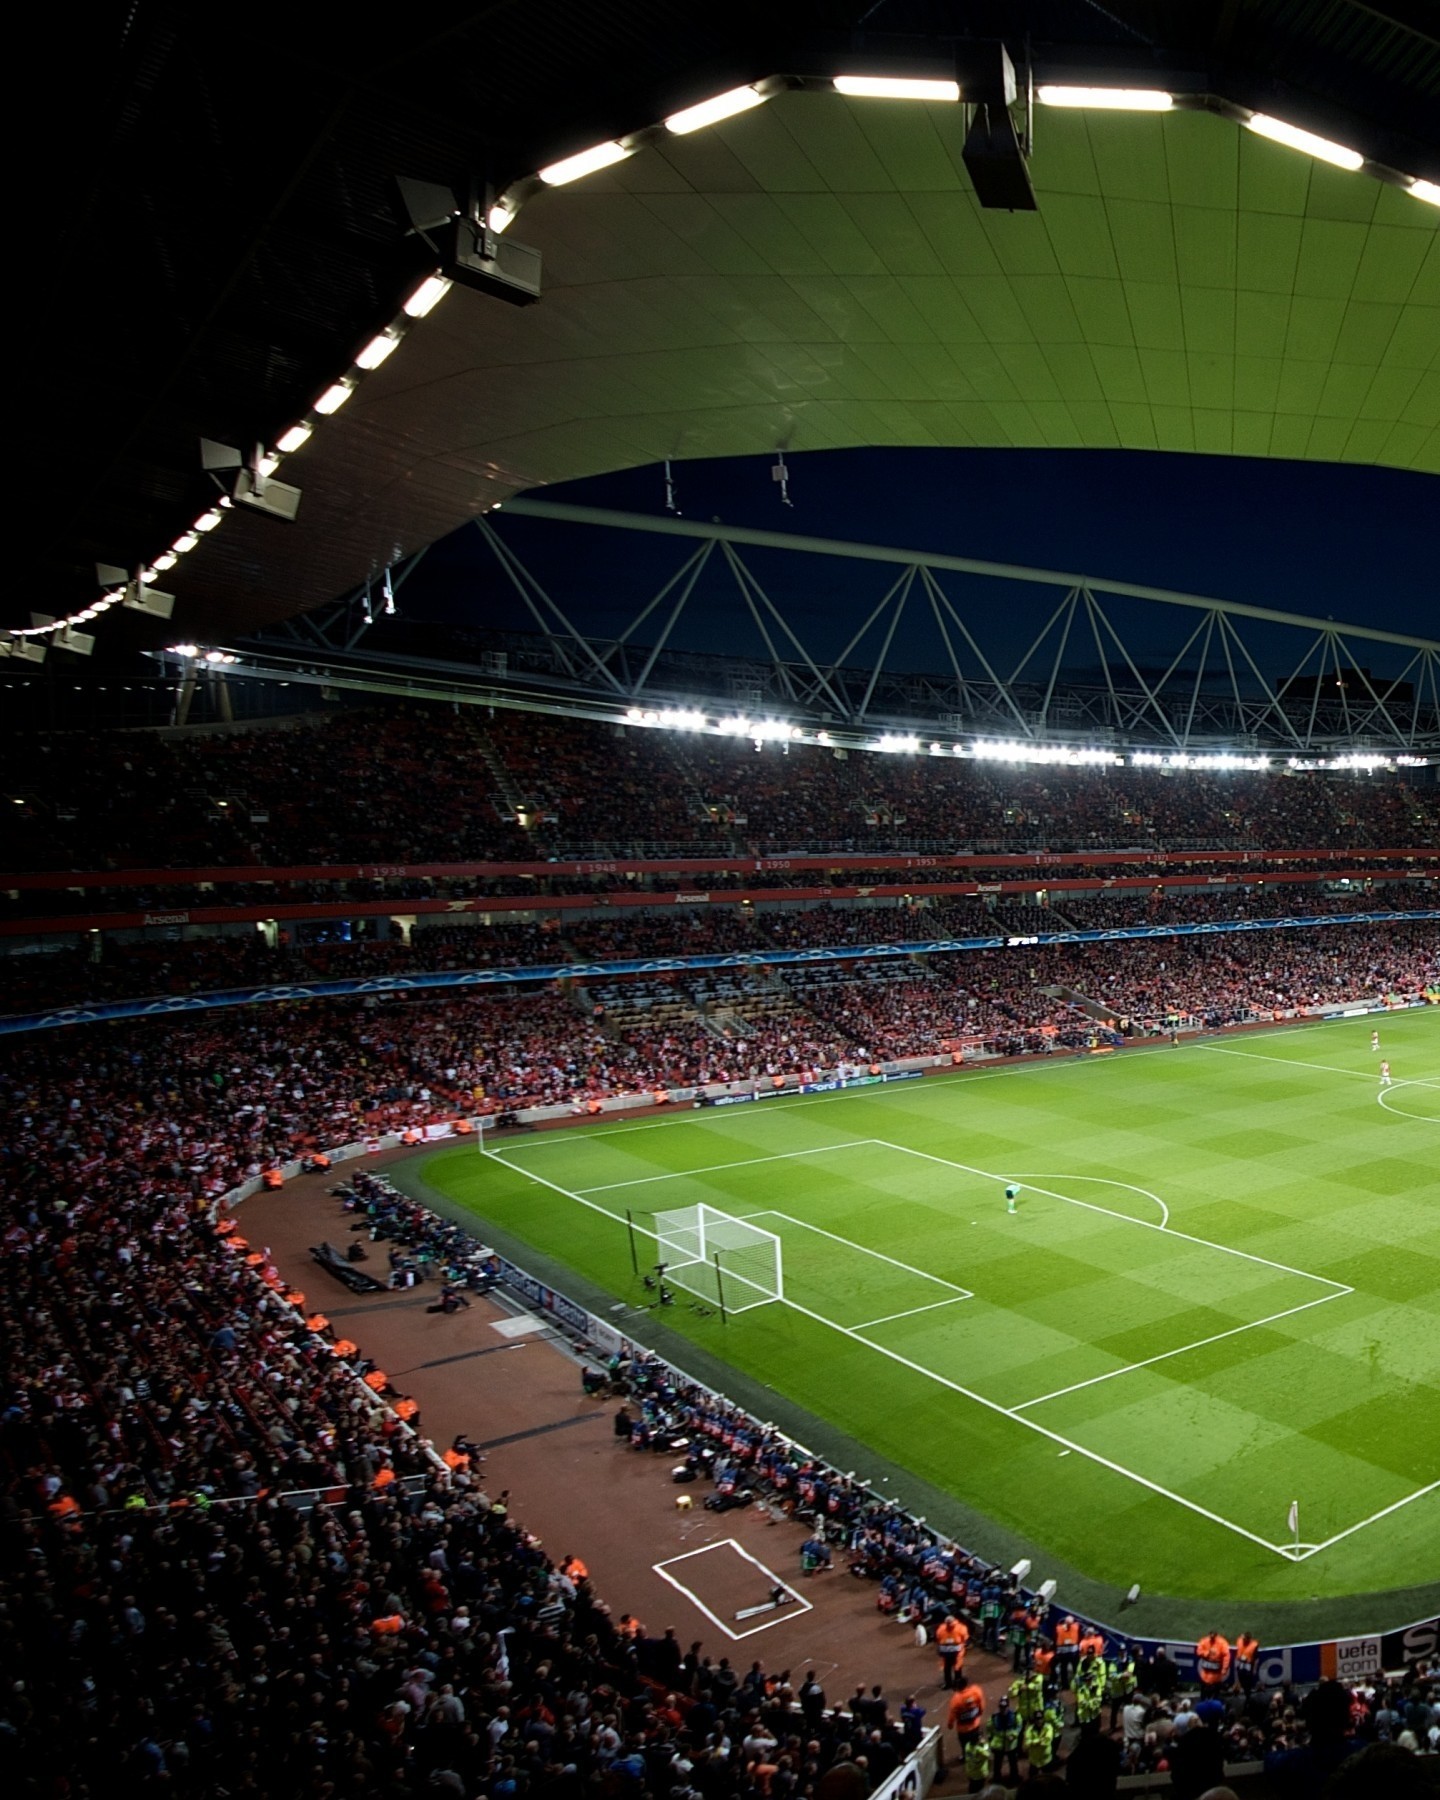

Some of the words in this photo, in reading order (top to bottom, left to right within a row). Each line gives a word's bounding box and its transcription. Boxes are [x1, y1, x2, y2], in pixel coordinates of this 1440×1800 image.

[766, 860, 790, 870] 1950
[916, 857, 937, 867] 1953
[1043, 855, 1062, 864] 1970
[371, 866, 406, 877] 1938
[587, 863, 616, 873] 1948
[674, 892, 711, 904] Arsenal
[143, 911, 189, 926] Arsenal
[1338, 1641, 1378, 1660] uefa
[1166, 1645, 1292, 1686] Fd
